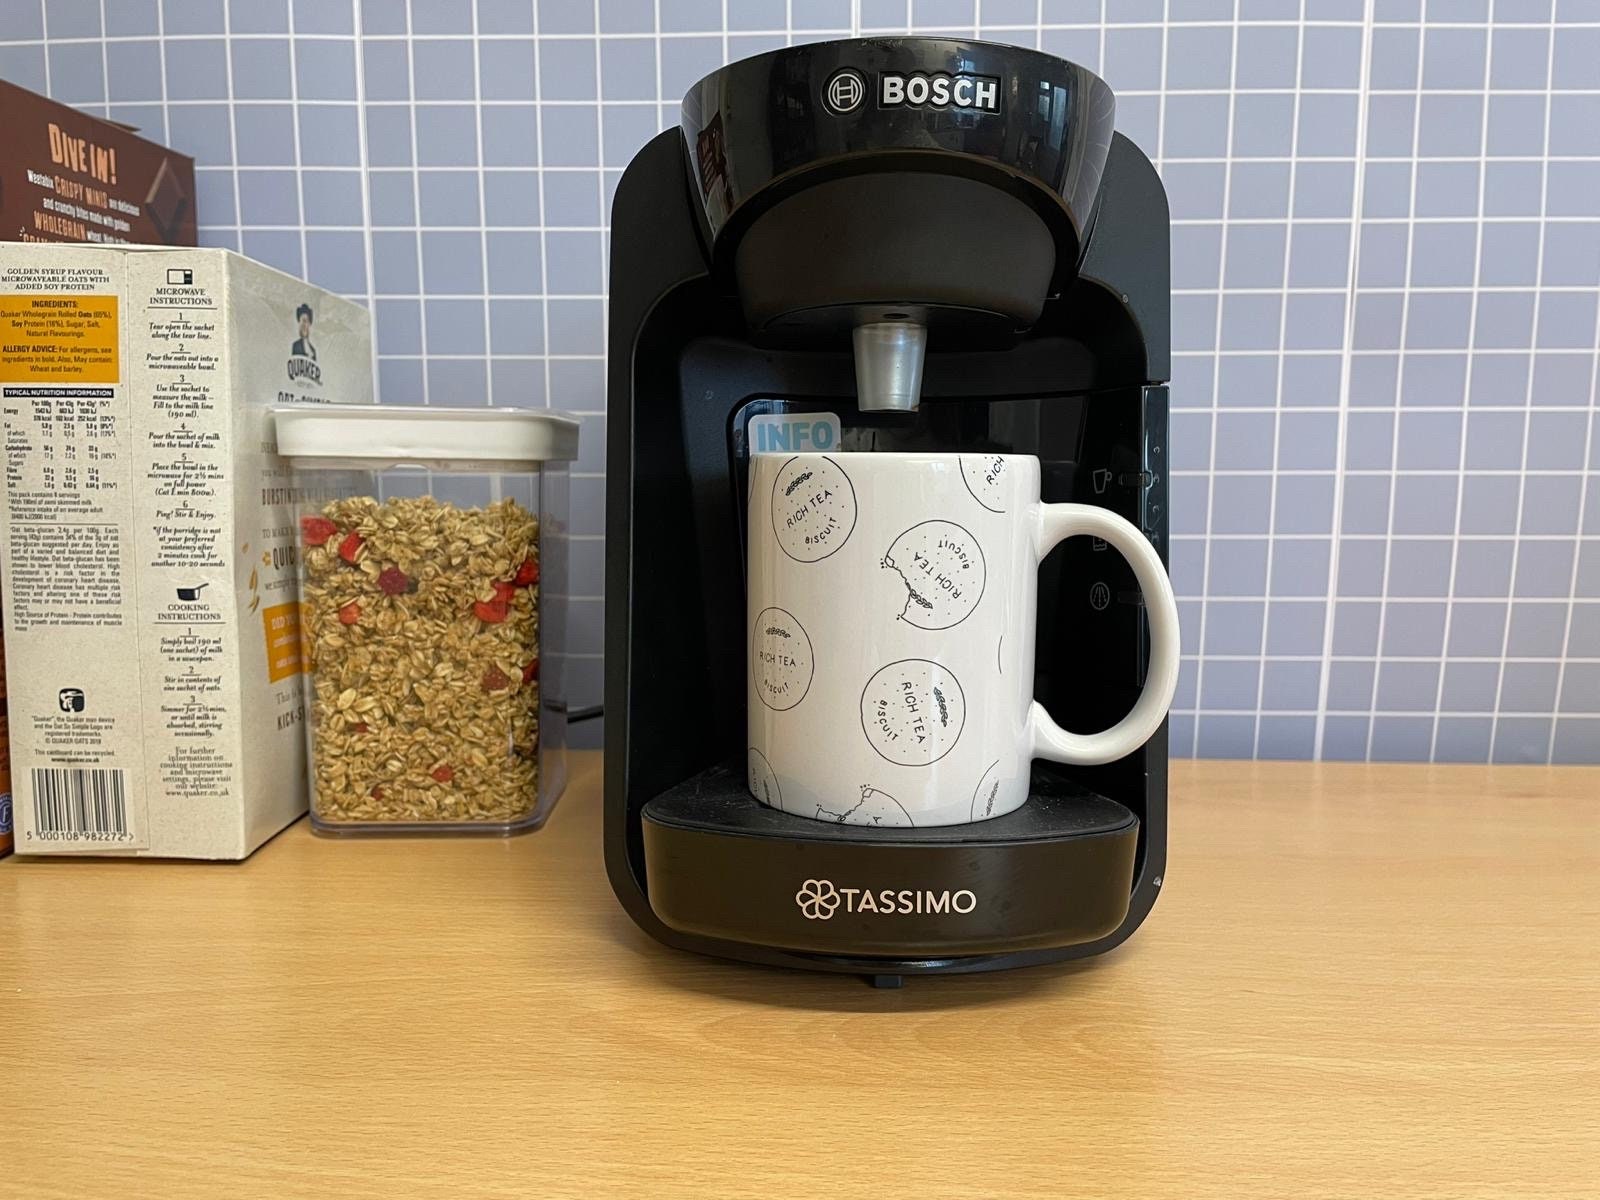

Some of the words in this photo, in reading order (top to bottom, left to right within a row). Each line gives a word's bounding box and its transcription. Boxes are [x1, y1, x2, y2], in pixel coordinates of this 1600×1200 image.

[883, 76, 996, 109] BOSCH
[48, 123, 88, 173] DIVE
[90, 143, 117, 185] IN!
[54, 175, 84, 201] CRISPY
[33, 210, 86, 240] WHOLEGRAIN
[68, 268, 104, 276] FLAVOUR
[32, 300, 78, 308] INGREDIENTS:
[150, 297, 212, 305] INSTRUCTIONS
[156, 288, 206, 296] MICROWAVE
[3, 345, 30, 353] ALLERGY
[178, 343, 184, 352] 2
[180, 374, 185, 383] 3
[288, 359, 322, 385] QUAKER
[757, 421, 833, 452] INFO
[986, 456, 1005, 485] RICH
[786, 505, 809, 529] RICH
[809, 490, 833, 509] TEA
[804, 517, 837, 545] BISCUIT
[914, 551, 935, 576] TEA
[938, 539, 970, 569] BISCUIT
[935, 572, 962, 599] RICH
[759, 651, 776, 664] RICH
[778, 655, 797, 667] TEA
[764, 680, 789, 695] BISCUIT
[877, 699, 899, 742] BISCUIT
[901, 680, 919, 713] RICH
[912, 716, 926, 744] TEA
[26, 831, 32, 840] 5
[40, 831, 79, 841] 000108
[84, 832, 124, 841] 982272
[839, 888, 977, 914] TASSIMO
